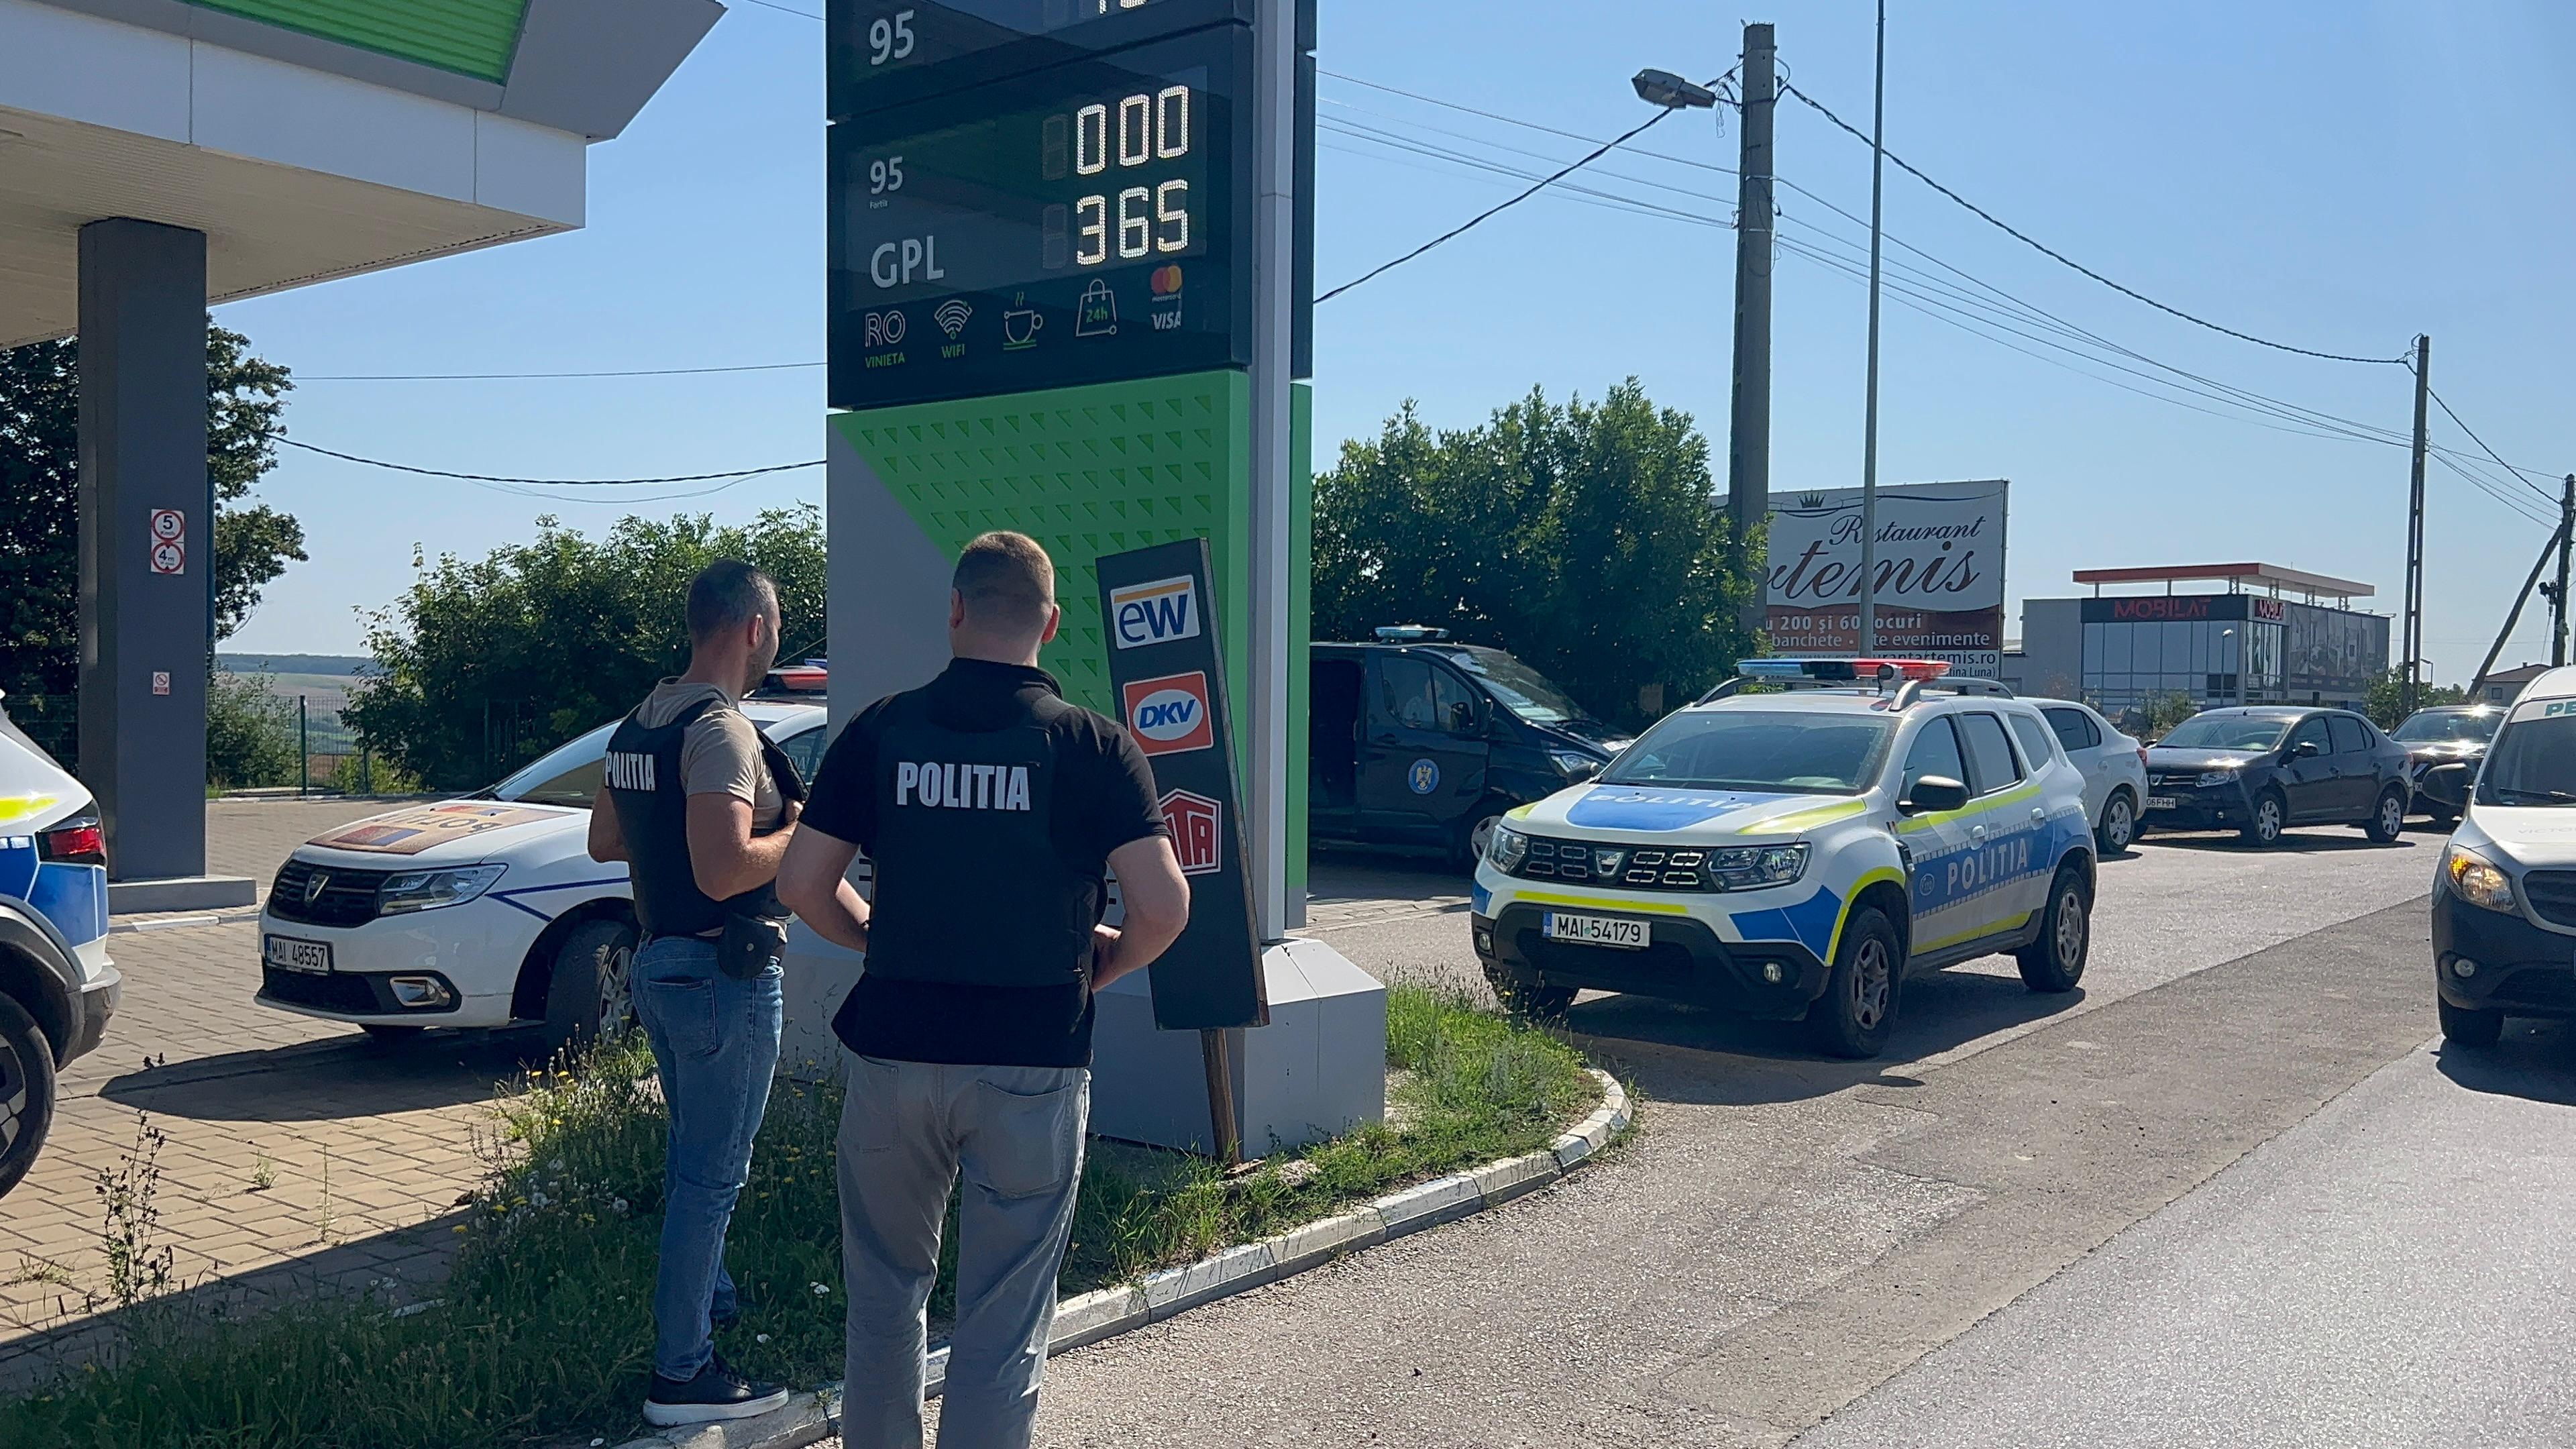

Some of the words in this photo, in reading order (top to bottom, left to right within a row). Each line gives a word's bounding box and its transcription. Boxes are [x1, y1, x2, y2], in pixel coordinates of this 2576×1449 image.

[869, 9, 914, 65] 95
[1077, 85, 1189, 175] 000
[870, 156, 903, 195] 95
[1077, 178, 1189, 265] 365
[871, 235, 945, 288] GPL
[865, 310, 906, 347] RO
[1085, 306, 1109, 323] 24h
[1150, 311, 1182, 330] VISA
[865, 352, 906, 369] VINIETA
[941, 343, 966, 359] WIFI
[162, 515, 173, 529] 5
[1829, 514, 1986, 545] Rstaurant
[1780, 616, 1811, 631] 200
[1874, 612, 1922, 629] ocuri
[2114, 598, 2212, 619] MOBILAT
[1772, 633, 1843, 647] banchete
[1892, 631, 1990, 646] evenimente
[1970, 667, 1996, 678] Luna)
[1140, 699, 1196, 729] DKV
[604, 751, 655, 791] POLITIA
[896, 762, 1031, 812] POLITIA
[1585, 794, 1752, 810] POLITIA
[1161, 797, 1214, 867] TA
[1947, 838, 2028, 896] POLITIA
[1557, 916, 1583, 937] MAI
[1590, 920, 1641, 943] 54179
[272, 940, 286, 962] MAI
[292, 944, 325, 968] 48557
